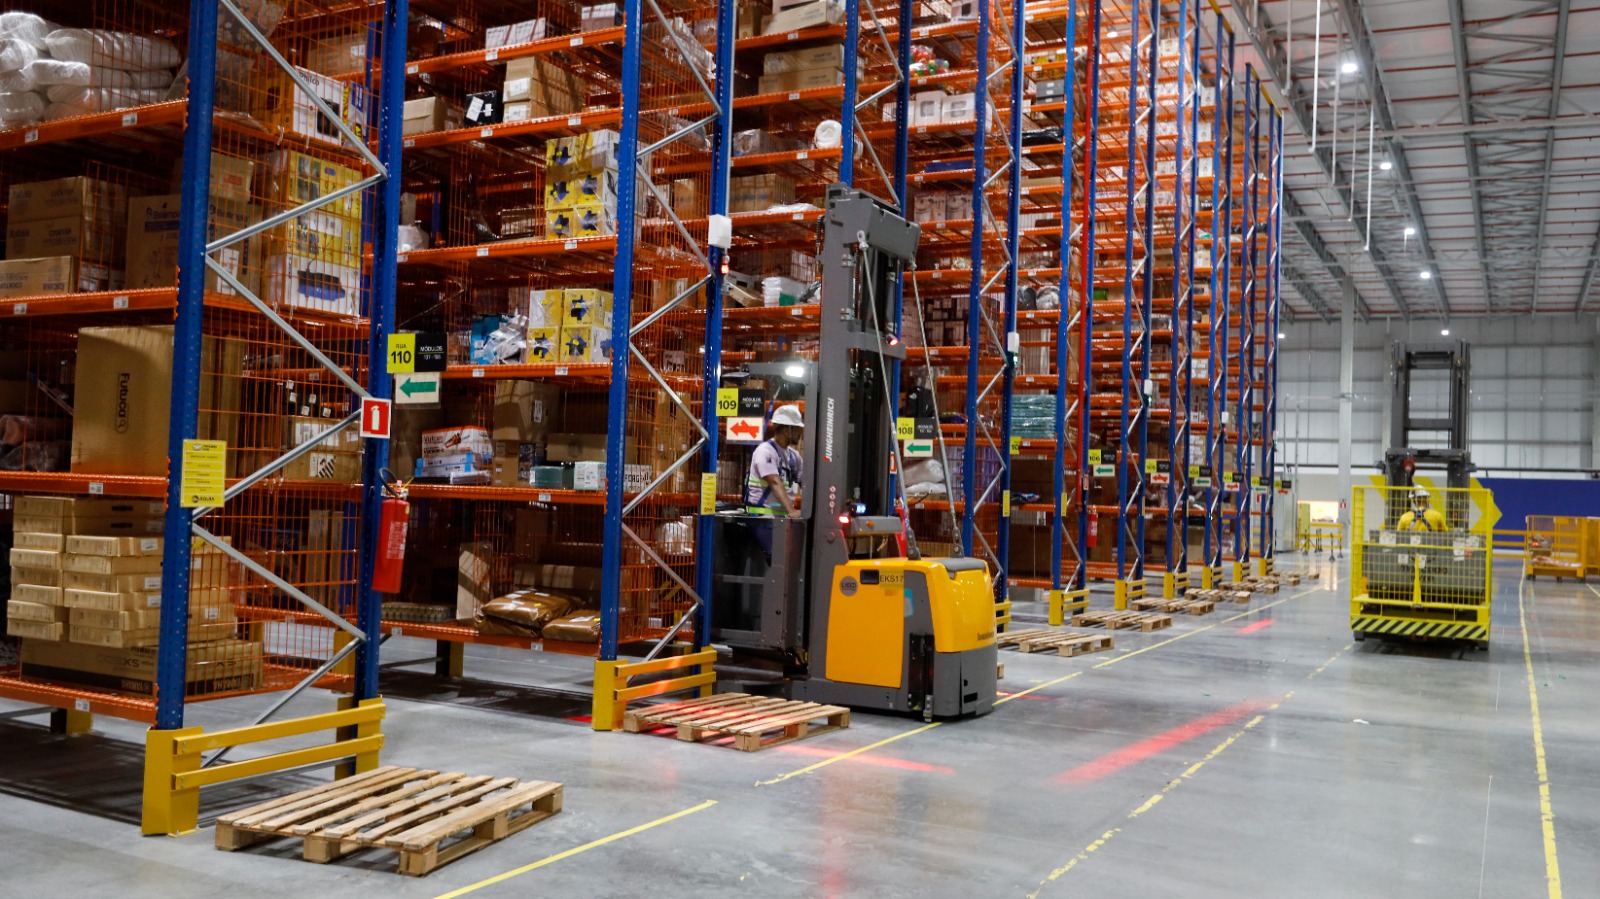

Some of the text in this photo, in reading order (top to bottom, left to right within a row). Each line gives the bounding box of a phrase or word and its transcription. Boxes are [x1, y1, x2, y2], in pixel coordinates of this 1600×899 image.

[390, 350, 412, 364] 110
[118, 373, 130, 418] Futuca
[718, 400, 737, 410] 109
[823, 397, 834, 463] JUNGHEINRICH
[879, 574, 905, 583] EKS17
